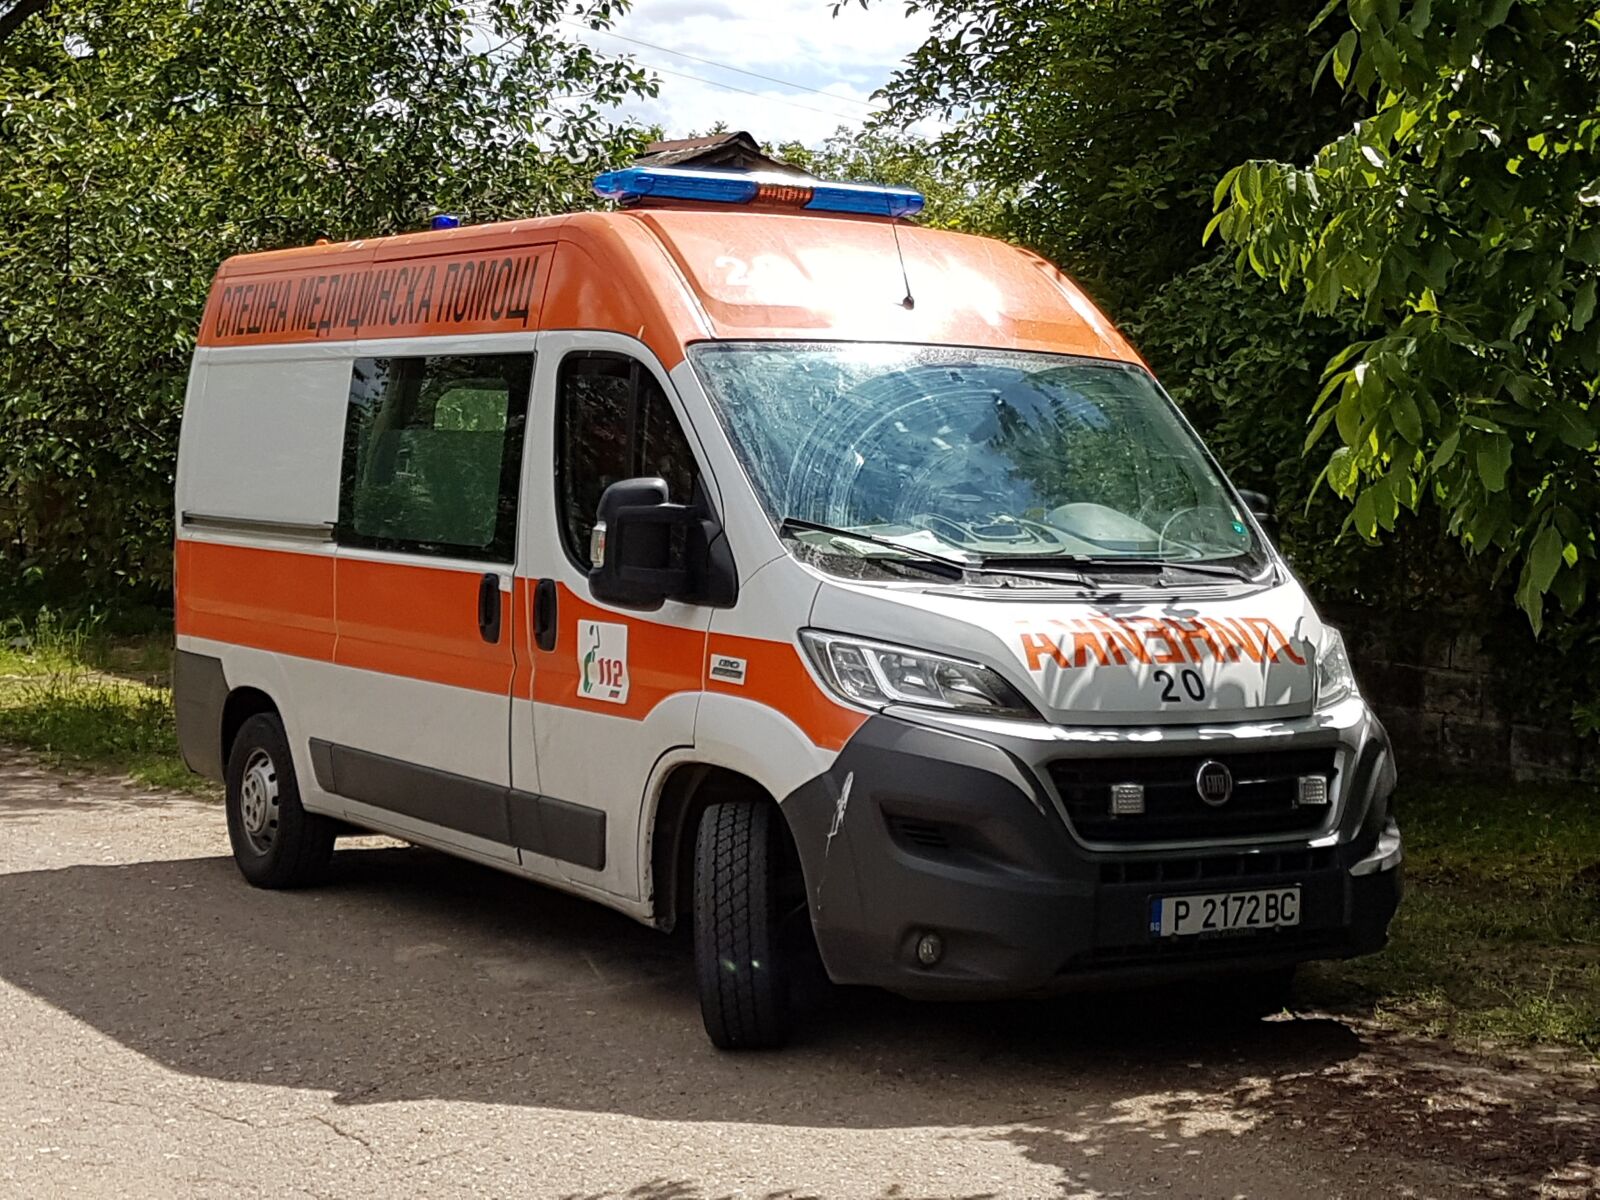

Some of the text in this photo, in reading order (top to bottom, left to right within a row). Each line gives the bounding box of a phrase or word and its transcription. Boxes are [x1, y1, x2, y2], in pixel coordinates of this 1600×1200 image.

[215, 255, 540, 338] СПЕШНА МЕДИЦИНСКА ПОМОЩ
[597, 657, 624, 689] 112
[1153, 669, 1206, 703] 20
